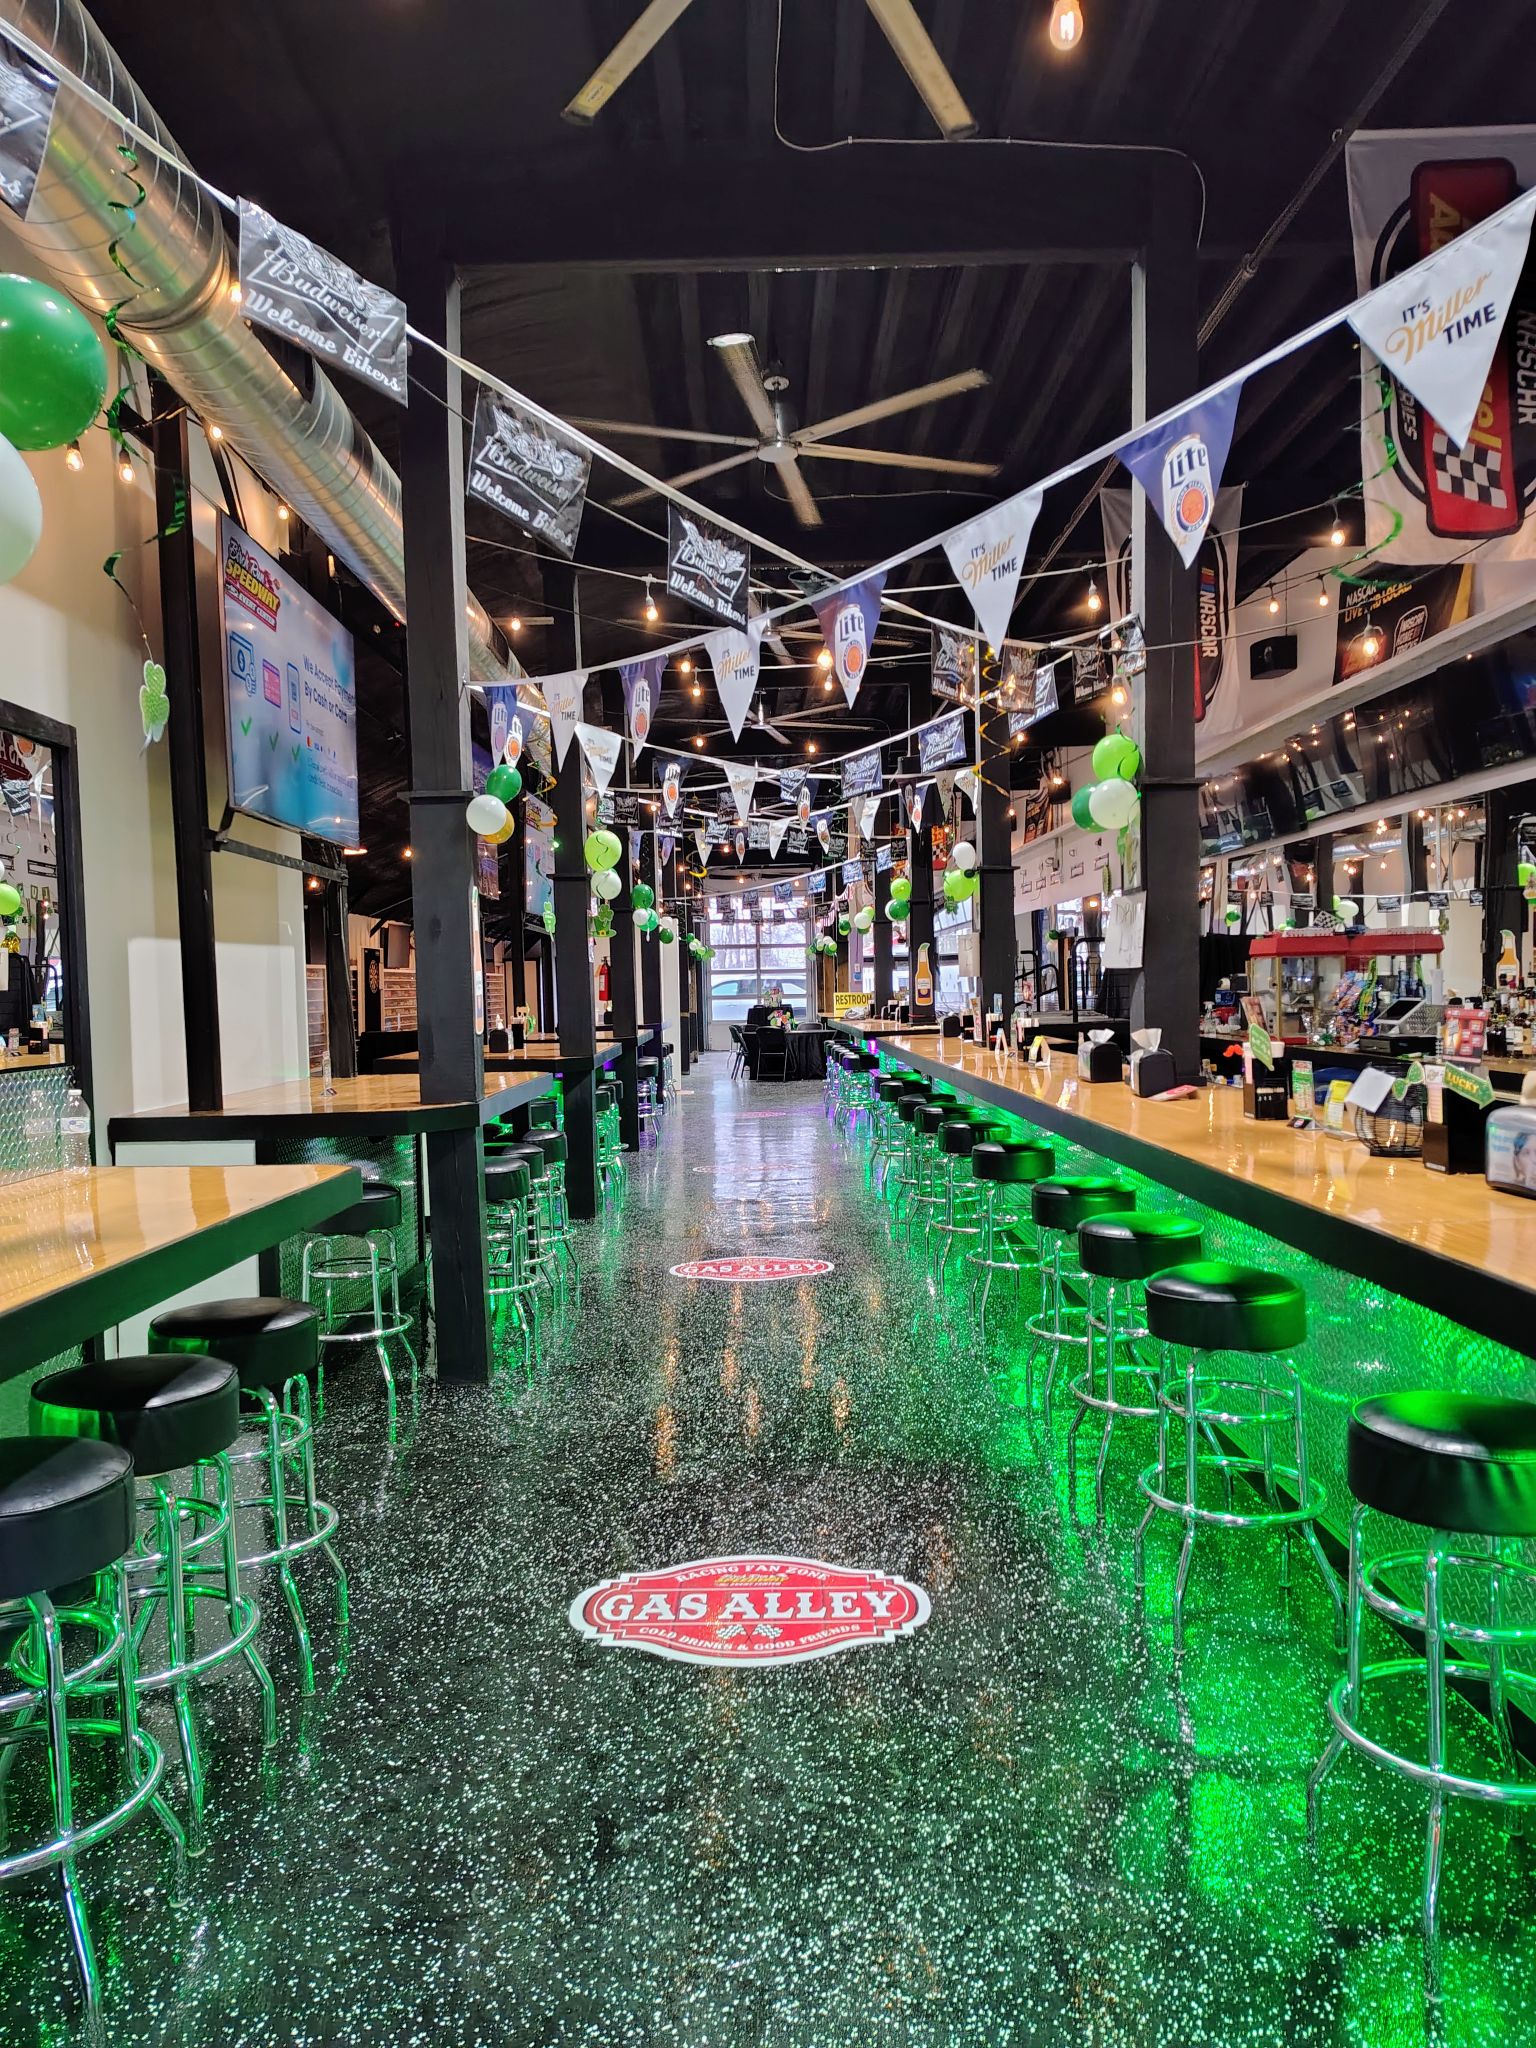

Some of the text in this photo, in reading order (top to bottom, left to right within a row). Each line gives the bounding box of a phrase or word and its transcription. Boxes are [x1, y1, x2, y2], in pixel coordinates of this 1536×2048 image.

[264, 249, 382, 340] Budweiser
[1402, 297, 1431, 324] IT'S
[1385, 271, 1493, 365] Miller
[1442, 303, 1497, 345] TIME
[244, 288, 402, 392] Welcome Bikers
[485, 436, 573, 502] Budweiser
[1168, 447, 1207, 489] Lite
[470, 470, 573, 547] Welcome Bikers
[680, 540, 738, 589] Budweiser
[961, 534, 1015, 590] Miller
[970, 542, 986, 560] IT'S
[991, 556, 1018, 582] TIME
[225, 559, 280, 611] SPEEDWAY
[670, 571, 746, 626] Welcome Bikers
[839, 614, 864, 642] Lite
[1200, 590, 1219, 658] NASCAR
[734, 665, 755, 680] TIME
[304, 681, 312, 704] By
[313, 688, 329, 711] Cash
[561, 711, 576, 720] TIME
[1447, 1071, 1479, 1093] LUCKY
[738, 1264, 820, 1273] ALLEY
[674, 1566, 739, 1583] RACING
[745, 1564, 781, 1572] FAN
[786, 1565, 829, 1581] ZONE
[600, 1591, 898, 1622] GAS ALLEY
[638, 1623, 861, 1651] COLD DRINKS & GOOD FRIENDS
